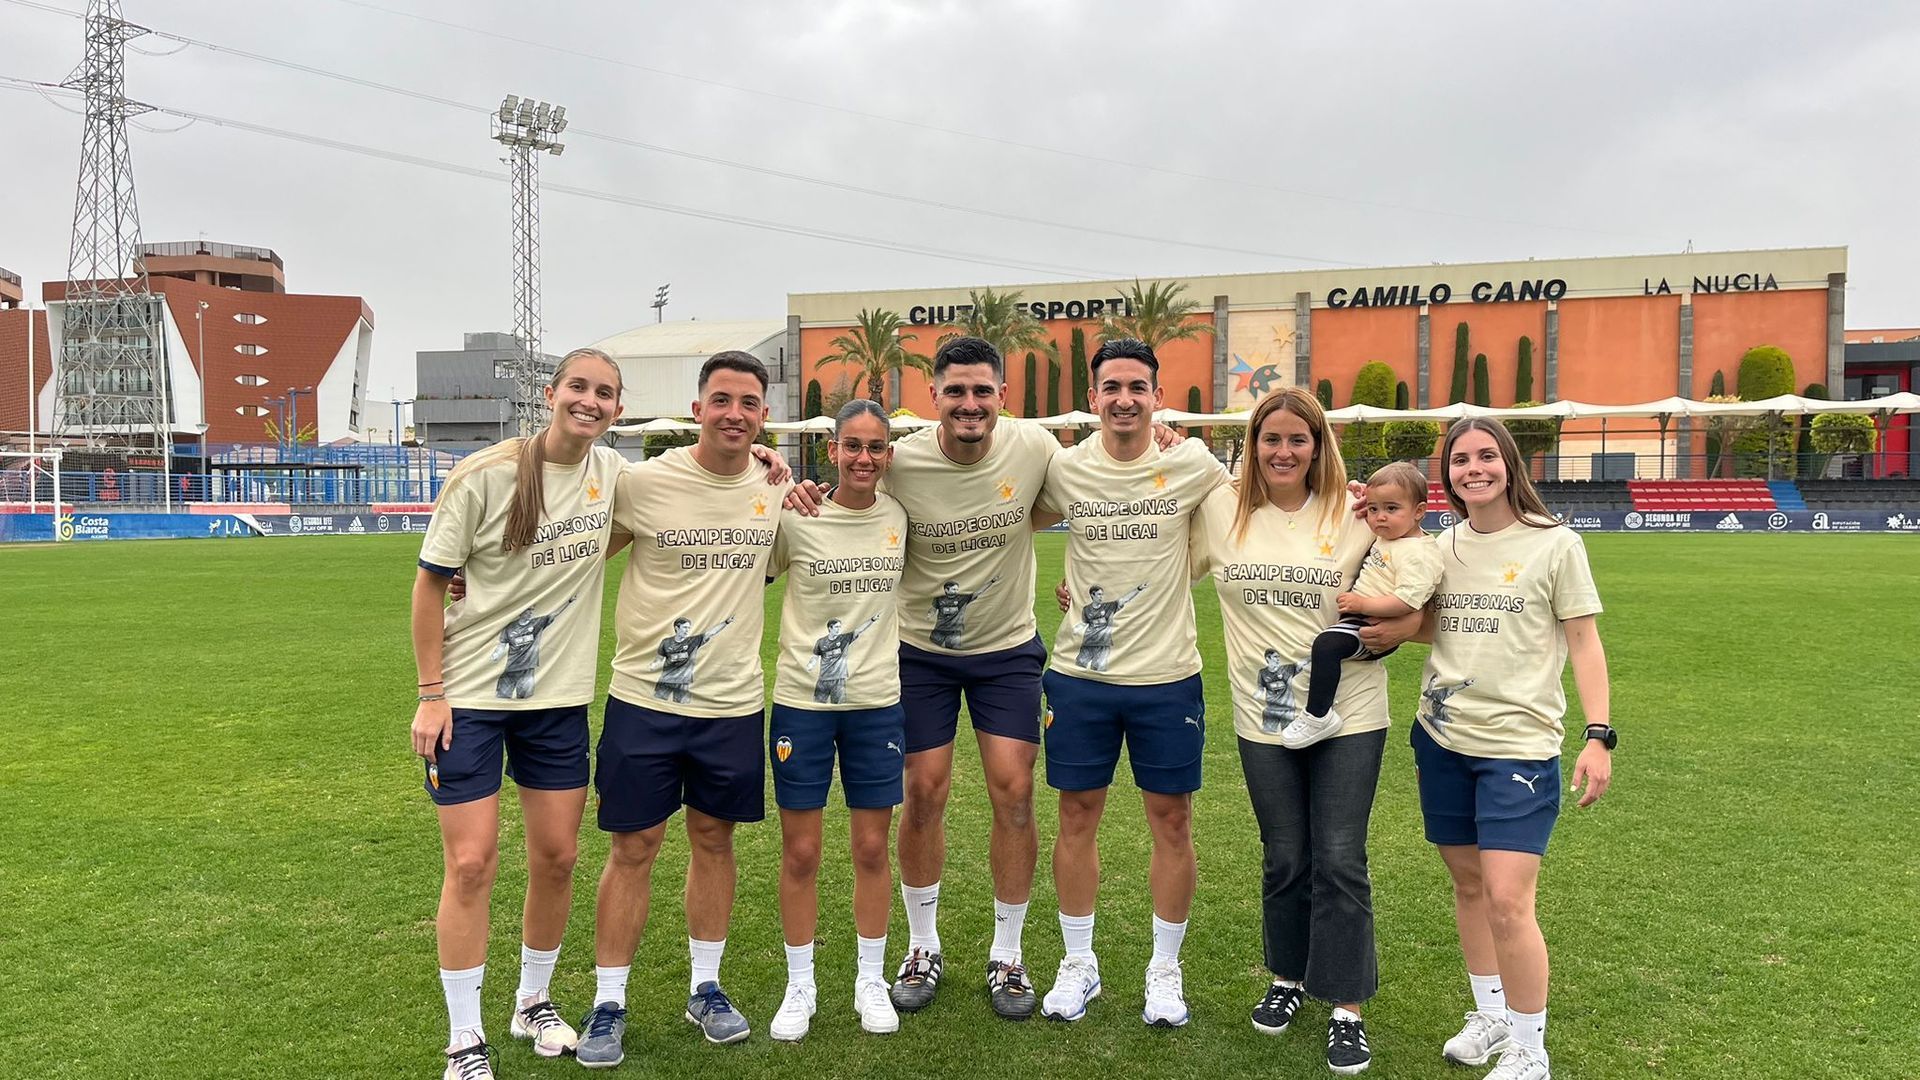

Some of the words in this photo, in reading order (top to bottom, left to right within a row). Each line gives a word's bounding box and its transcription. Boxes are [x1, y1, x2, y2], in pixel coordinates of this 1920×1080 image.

[1644, 277, 1671, 295] LA
[1693, 273, 1779, 294] NUCIA
[1326, 283, 1452, 309] CAMILO
[1471, 279, 1567, 304] CANO
[1069, 499, 1178, 520] ¡CAMPEONAS
[75, 525, 109, 534] Blanca
[80, 516, 109, 526] Costa
[225, 519, 242, 534] LA
[656, 529, 774, 548] ¡CAMPEONAS
[1085, 525, 1108, 541] DE
[1112, 524, 1158, 540] LIGA!
[931, 542, 956, 554] DE
[961, 534, 1006, 552] LIGA!
[532, 548, 555, 569] DE
[681, 554, 706, 570] DE
[712, 553, 756, 570] LIGA!
[1223, 564, 1343, 588] ¡CAMPEONAS
[830, 580, 851, 595] DE
[855, 578, 894, 593] LIGA!
[1243, 588, 1267, 605] DE
[1273, 590, 1321, 610] LIGA!
[1434, 594, 1525, 614] CAMPEONAS
[1441, 616, 1459, 632] DE
[1462, 617, 1499, 634] LIGA!
